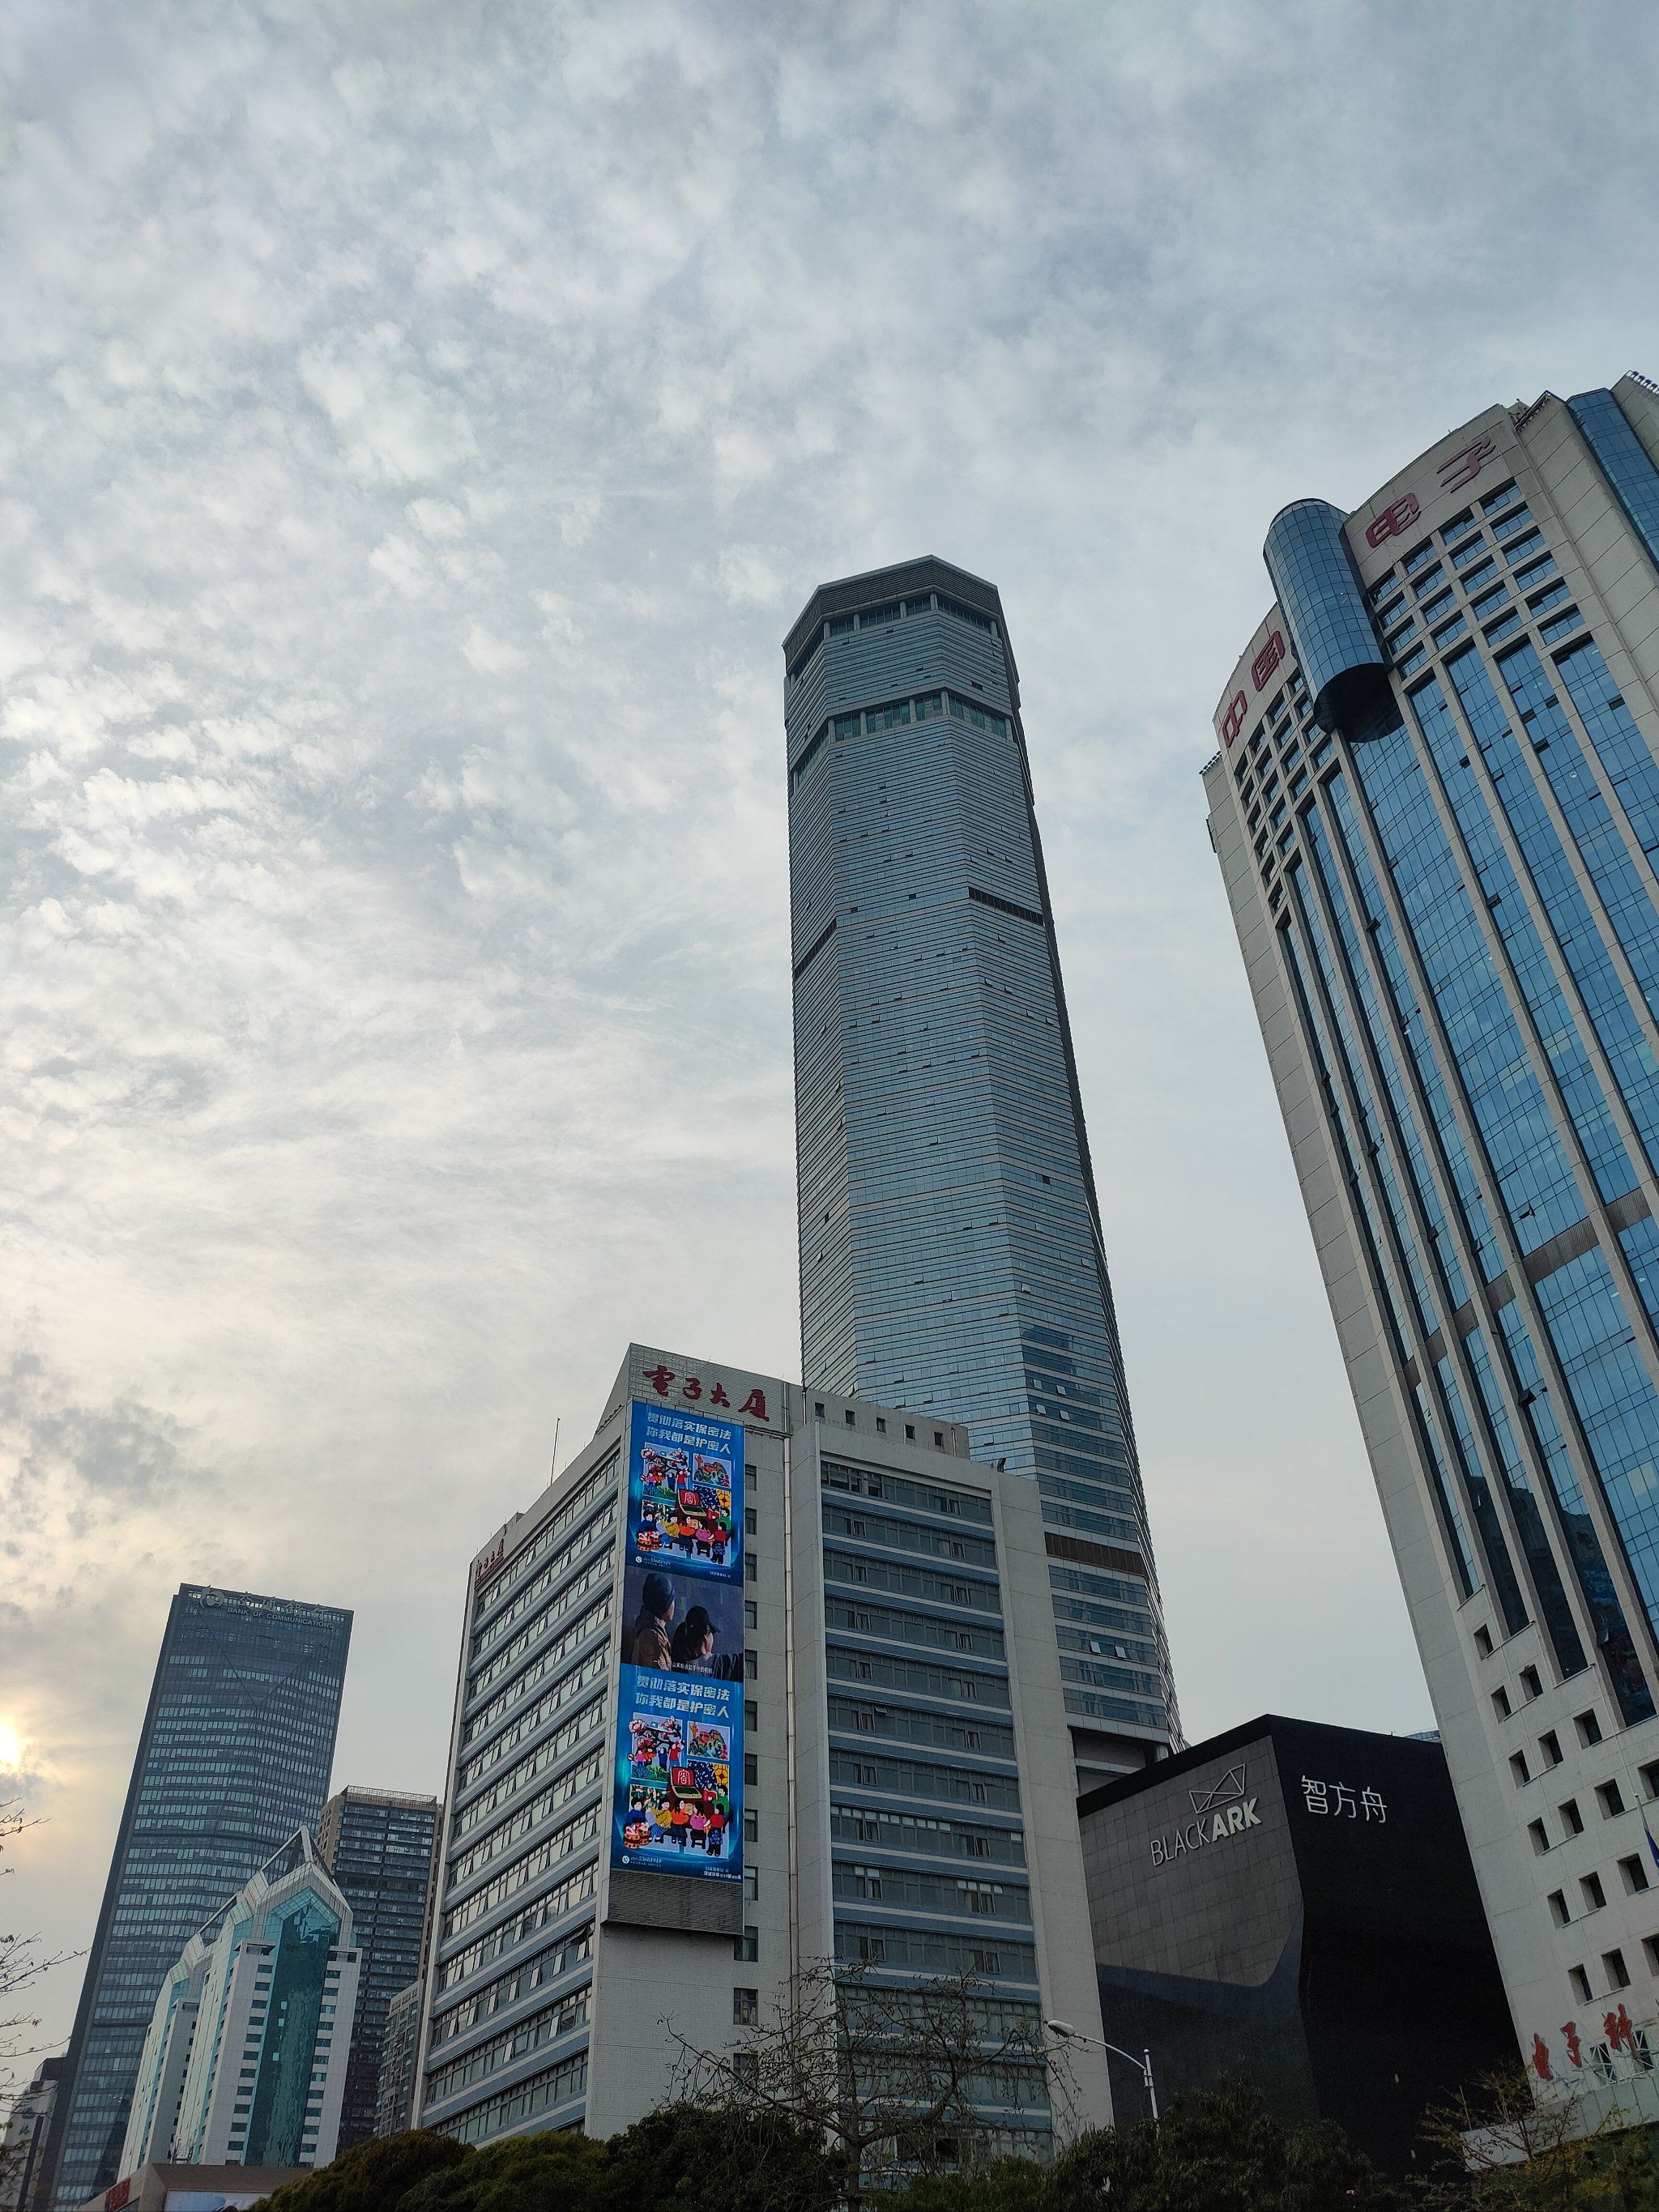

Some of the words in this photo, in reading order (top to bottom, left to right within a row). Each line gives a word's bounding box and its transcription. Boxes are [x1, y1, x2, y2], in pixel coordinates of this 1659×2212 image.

[647, 1412, 731, 1440] 贯彻落实保密法
[646, 1426, 731, 1455] 你我都是护密人
[228, 1607, 249, 1616] BANK
[253, 1609, 264, 1617] OF
[267, 1613, 335, 1630] COMMUNICATIONS
[637, 1674, 731, 1701] 贯彻落实保密法
[635, 1692, 730, 1719] 你我都是护密人
[1301, 1775, 1387, 1823] 智方舟
